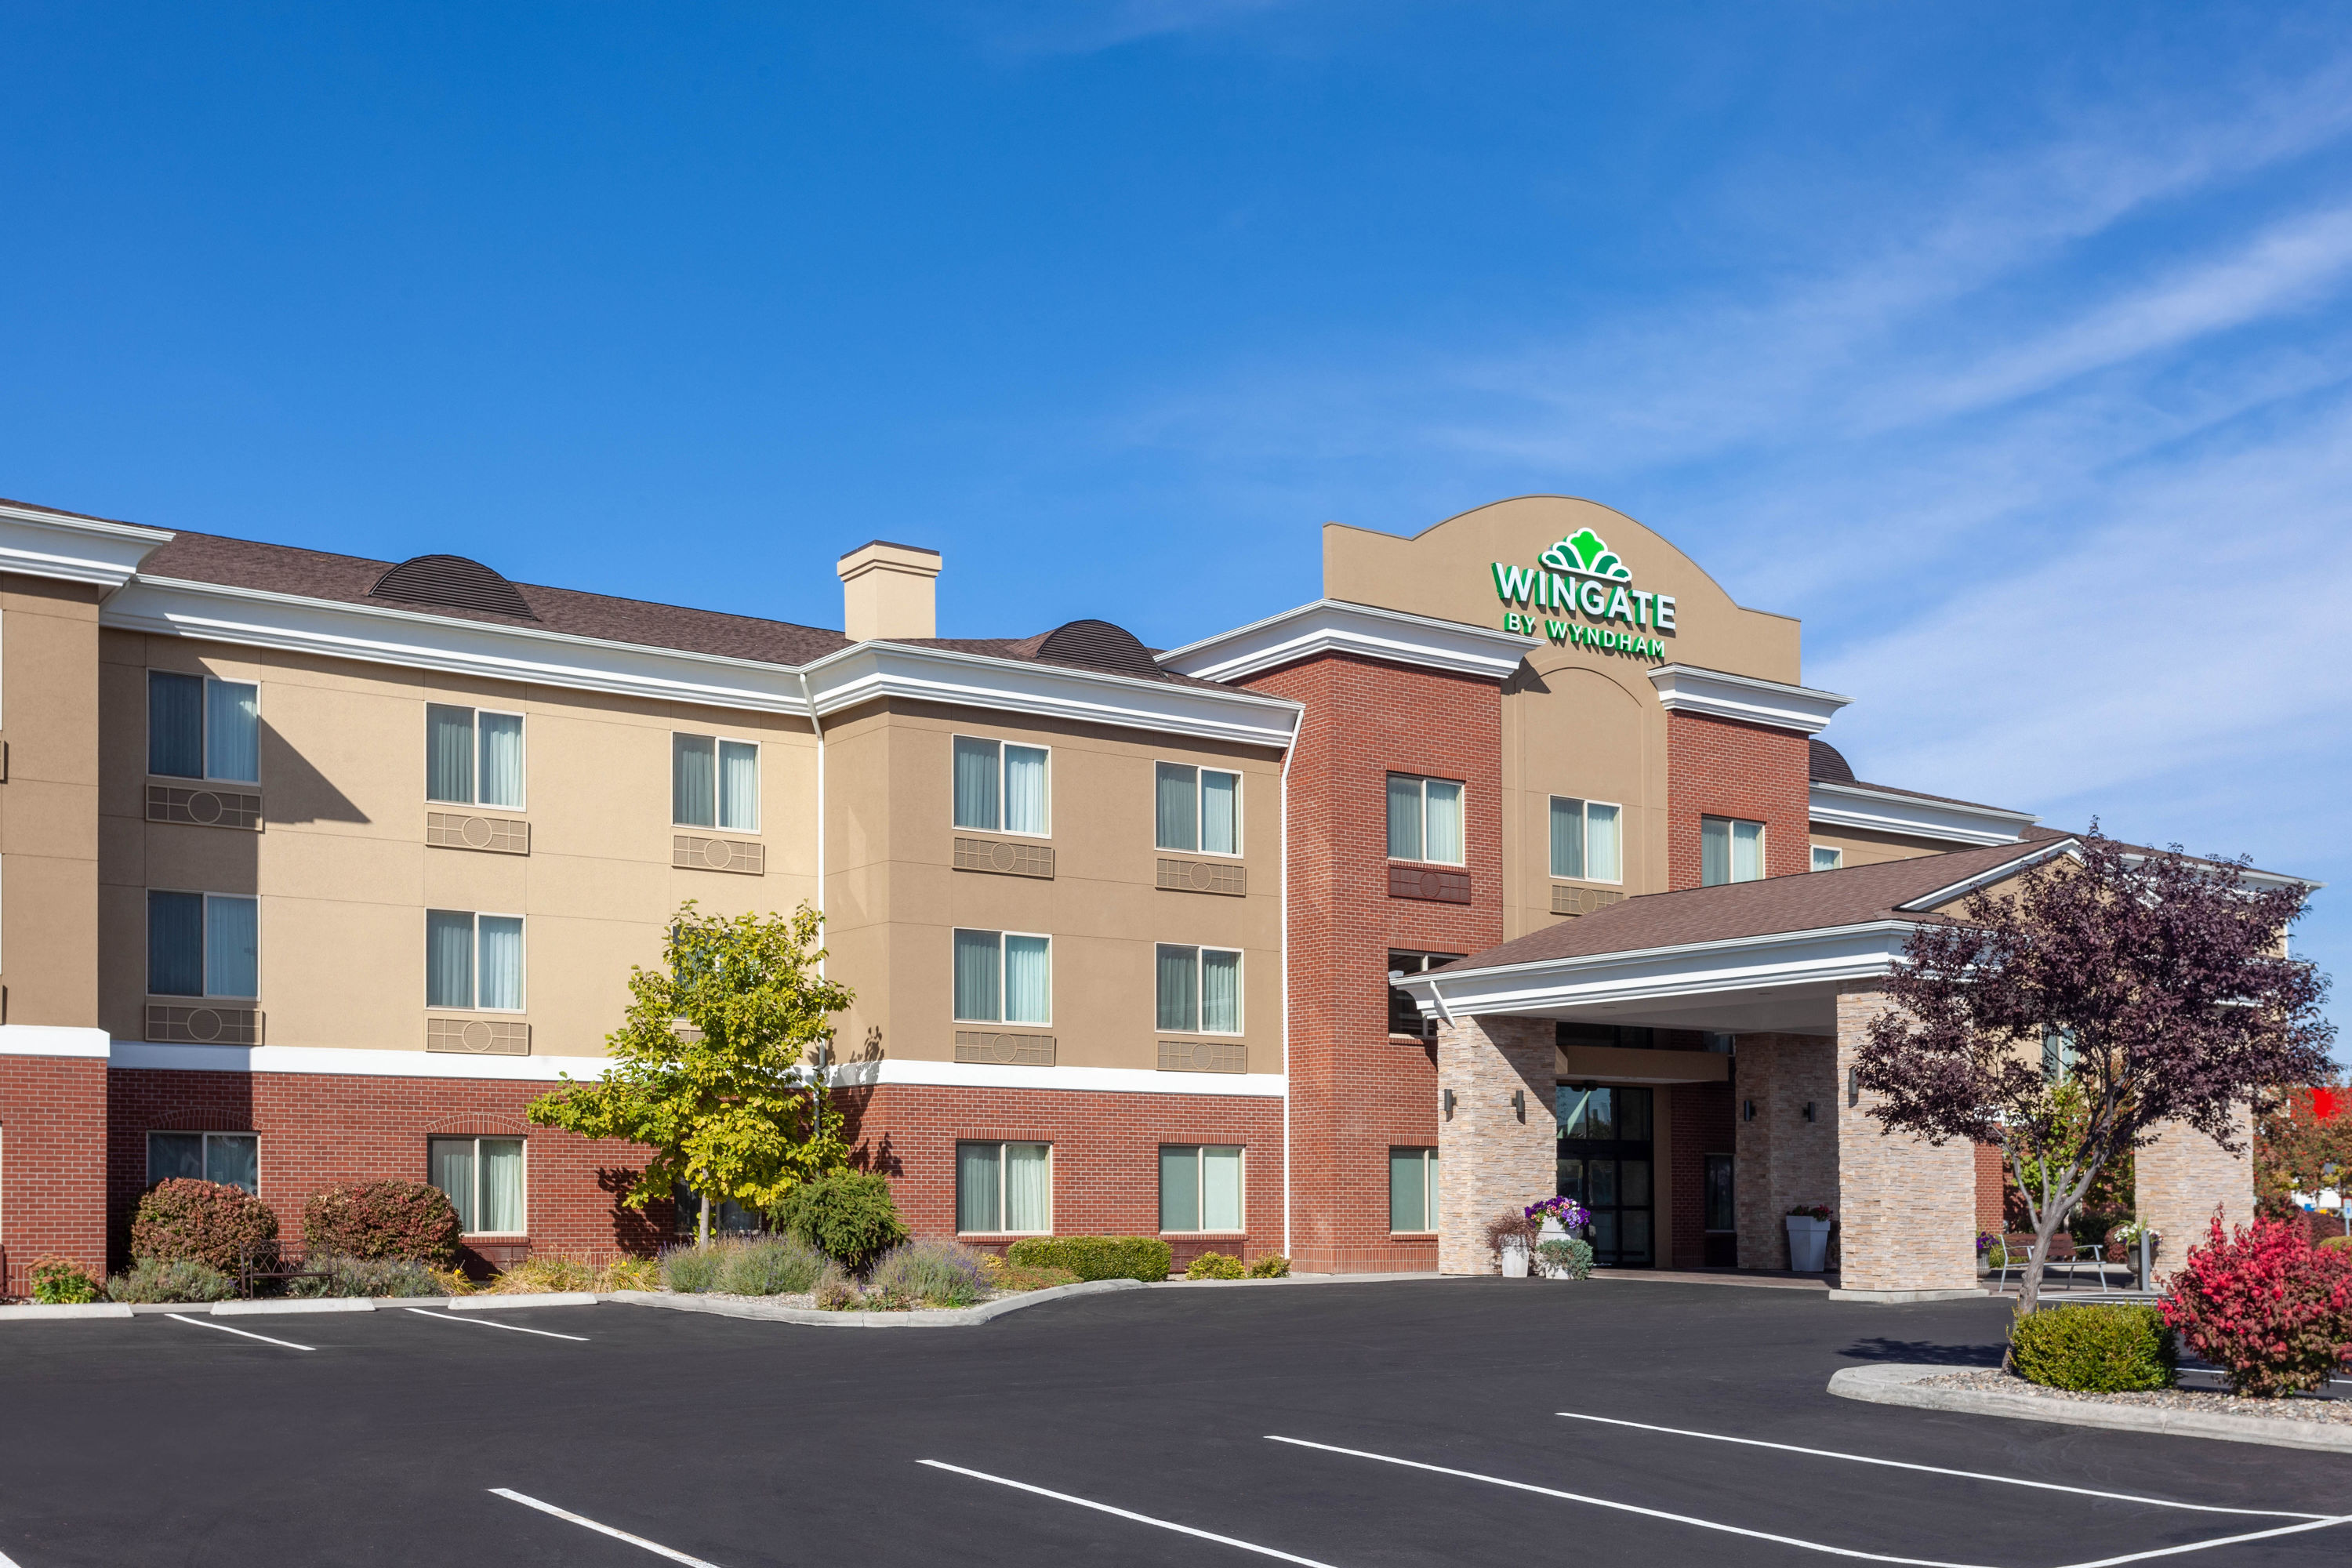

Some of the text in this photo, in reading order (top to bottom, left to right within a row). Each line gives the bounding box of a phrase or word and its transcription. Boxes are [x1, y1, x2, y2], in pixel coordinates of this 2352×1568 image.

[1492, 561, 1676, 630] WINGATE
[1504, 612, 1665, 658] BY WYNDHAM
